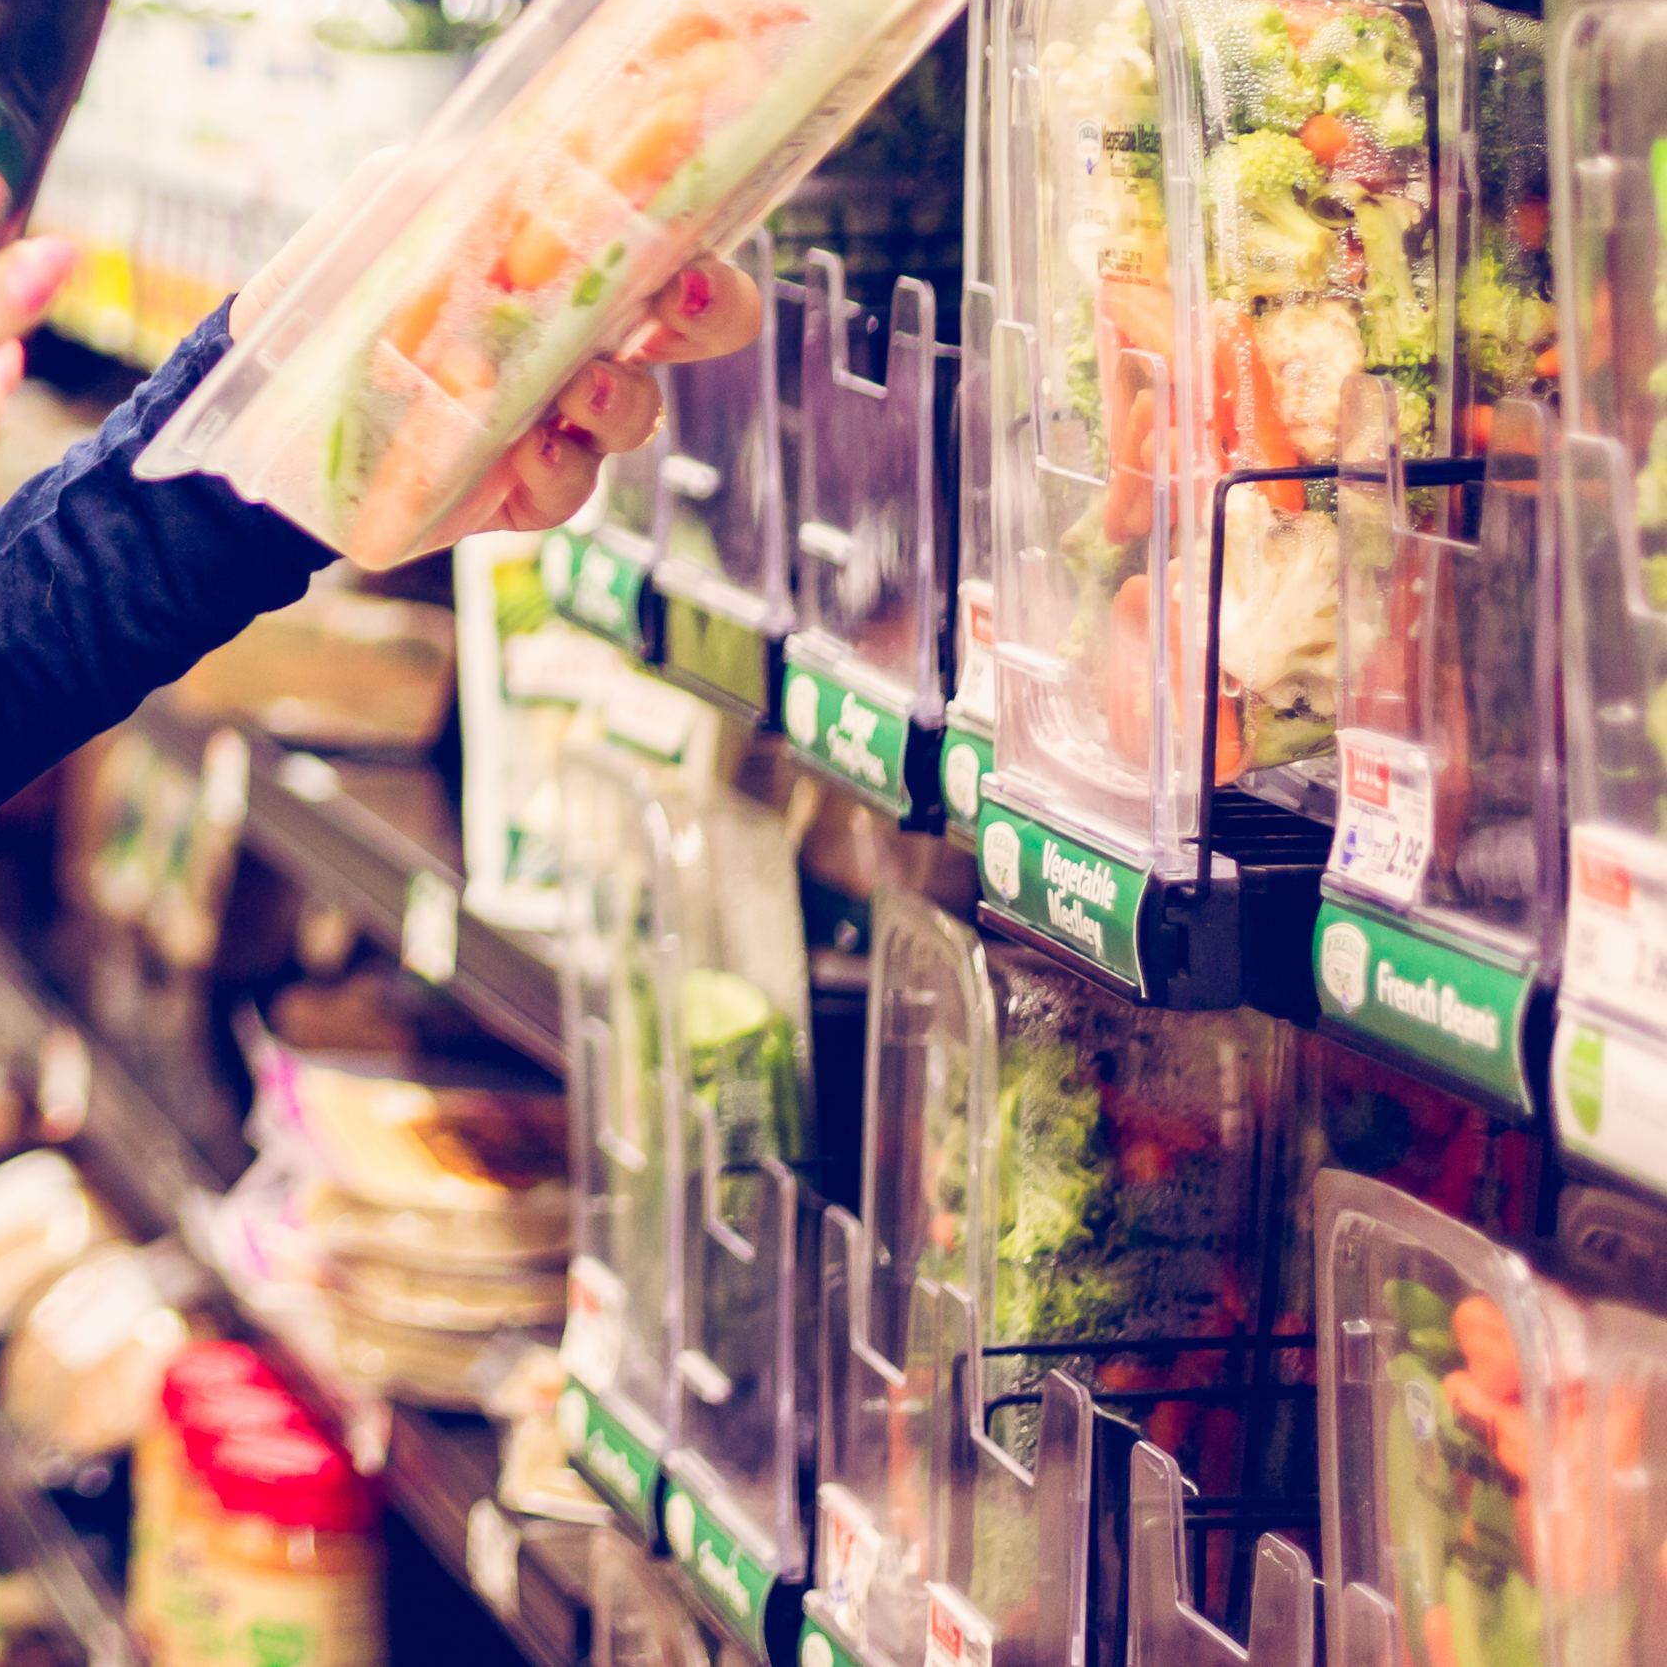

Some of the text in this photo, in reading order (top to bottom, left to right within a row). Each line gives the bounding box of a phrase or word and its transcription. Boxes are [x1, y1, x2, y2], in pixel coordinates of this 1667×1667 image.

[1041, 838, 1117, 912] Vegetable
[1046, 887, 1104, 958] Medley
[1376, 959, 1500, 1051] French Beans
